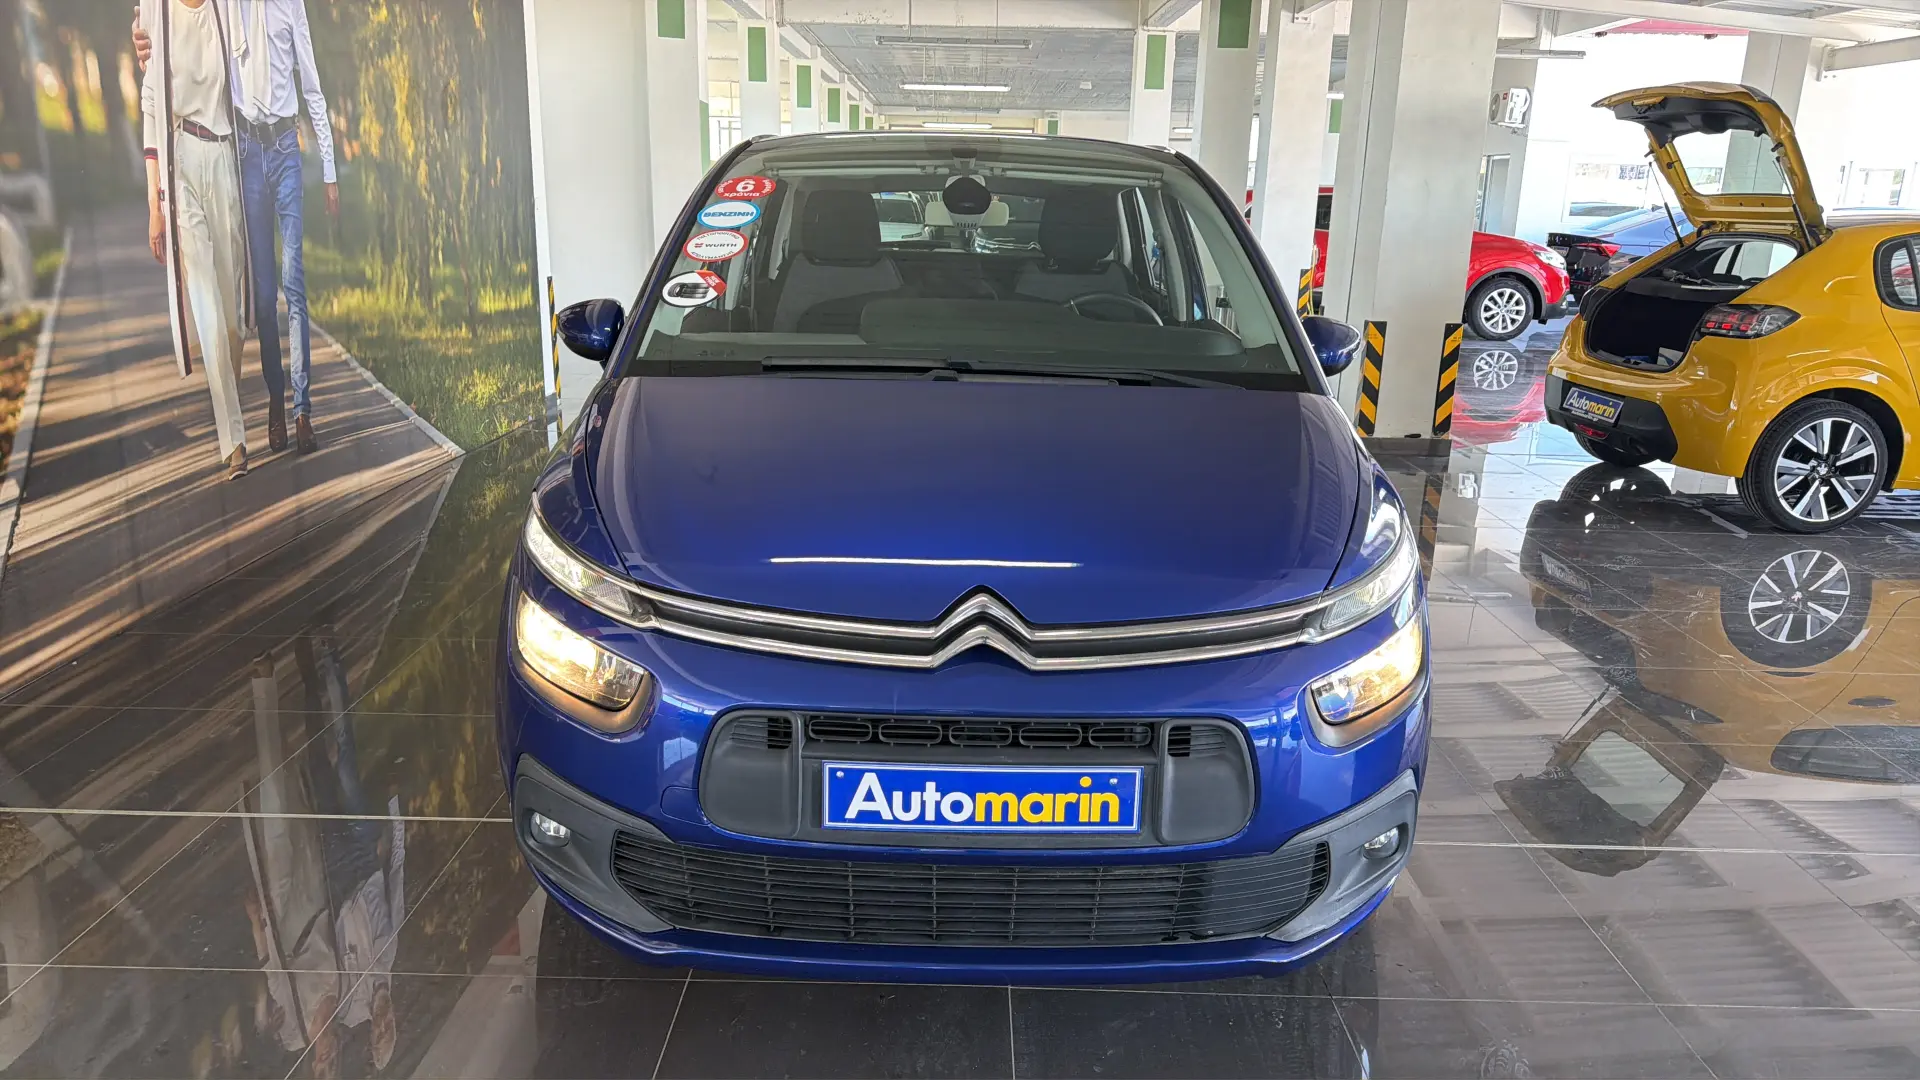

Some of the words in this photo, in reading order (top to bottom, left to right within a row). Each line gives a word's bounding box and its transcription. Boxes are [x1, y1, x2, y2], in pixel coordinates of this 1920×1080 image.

[736, 180, 756, 193] 6
[1567, 391, 1616, 418] Automarin
[844, 772, 1120, 823] Automarin
